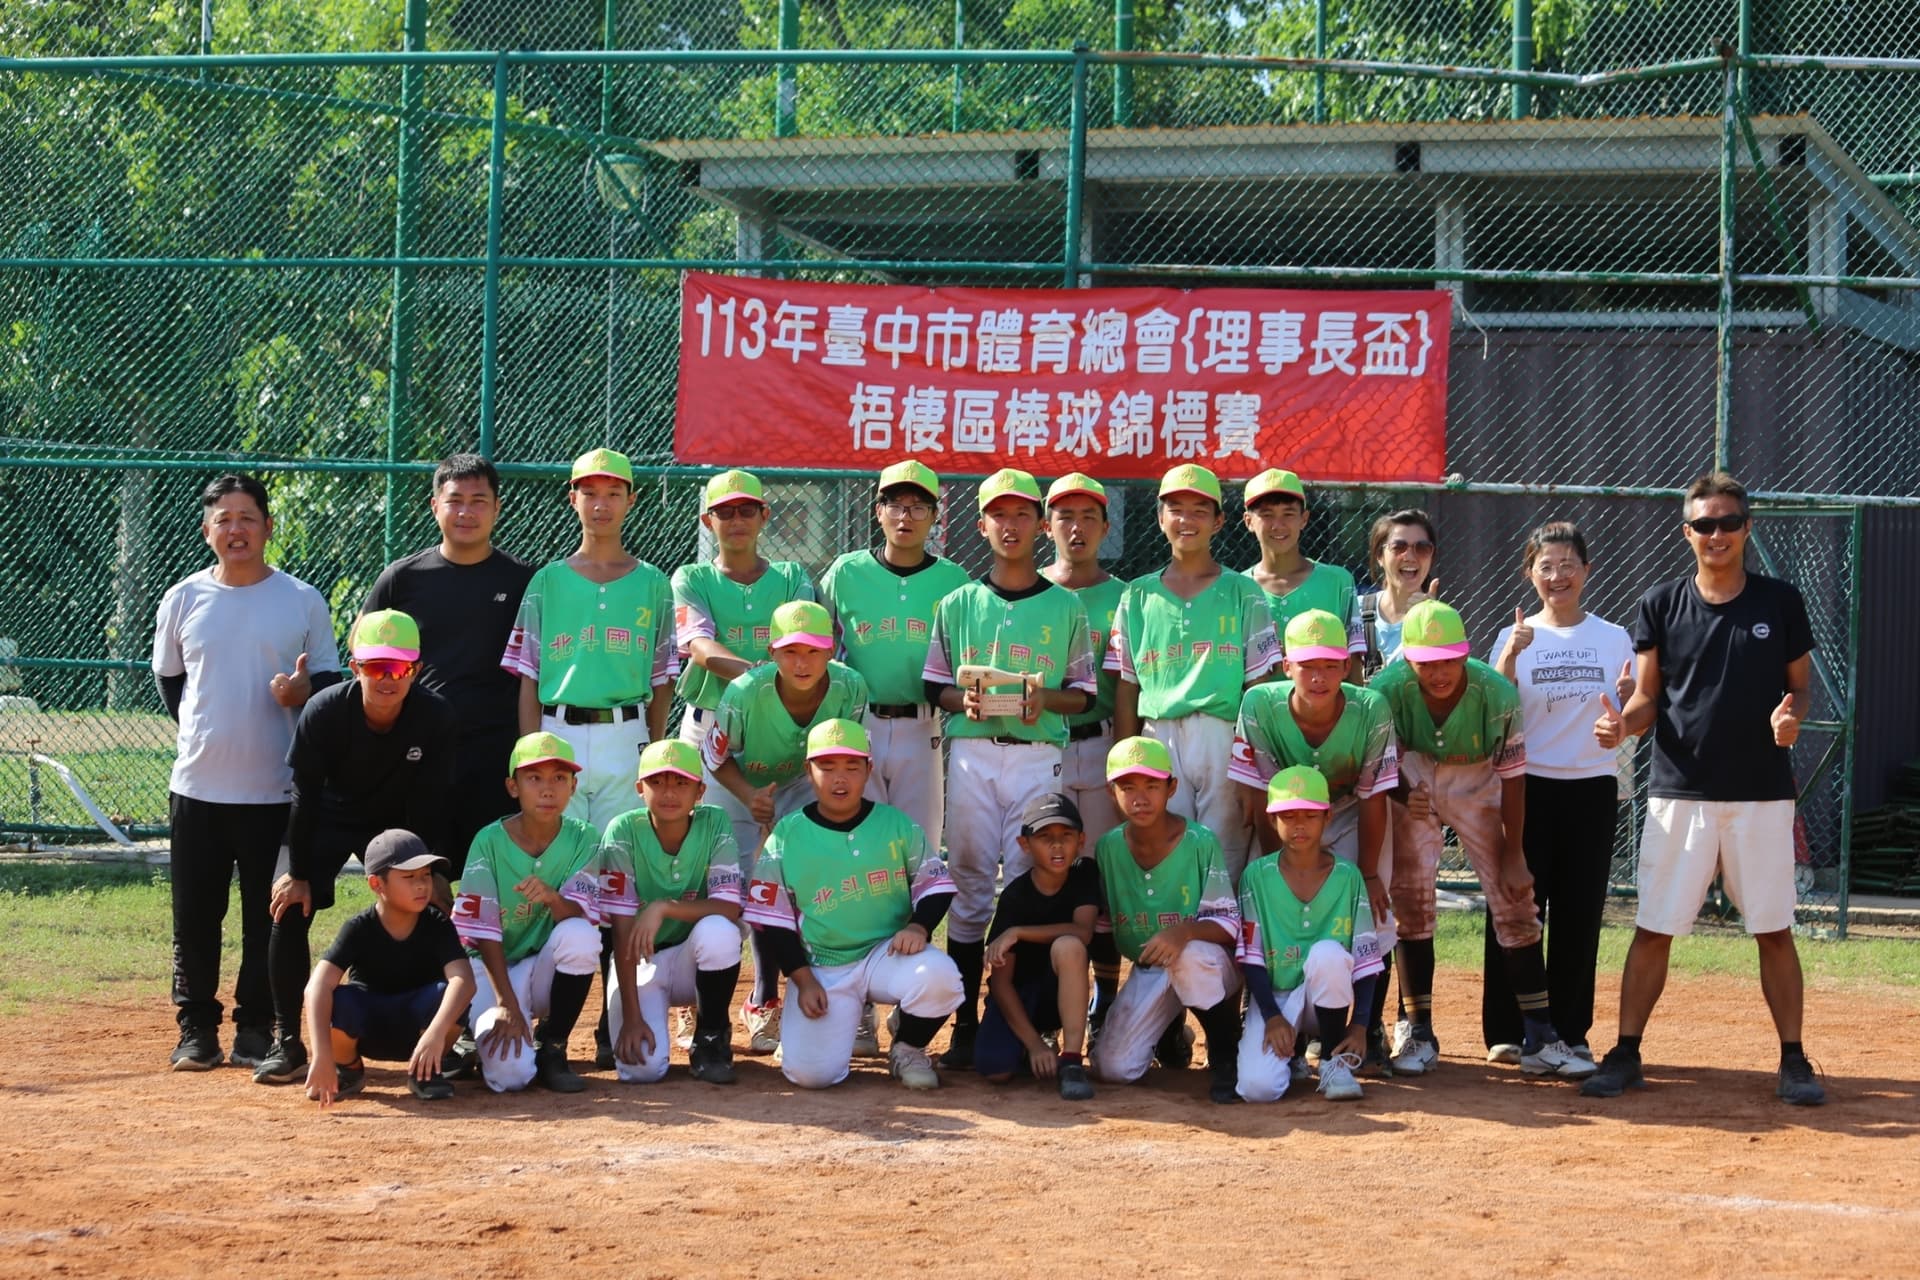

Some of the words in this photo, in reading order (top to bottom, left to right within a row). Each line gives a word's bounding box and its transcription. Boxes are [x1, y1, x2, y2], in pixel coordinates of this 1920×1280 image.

[695, 293, 1432, 376] 113年臺中市體育總會{理事長盃}
[848, 381, 1262, 459] 梧棲區棒球錦標賽
[1038, 624, 1053, 645] 3
[1218, 615, 1236, 635] 11
[1543, 650, 1575, 660] WAKE
[1576, 651, 1592, 659] UP
[1537, 668, 1601, 680] AWESOME
